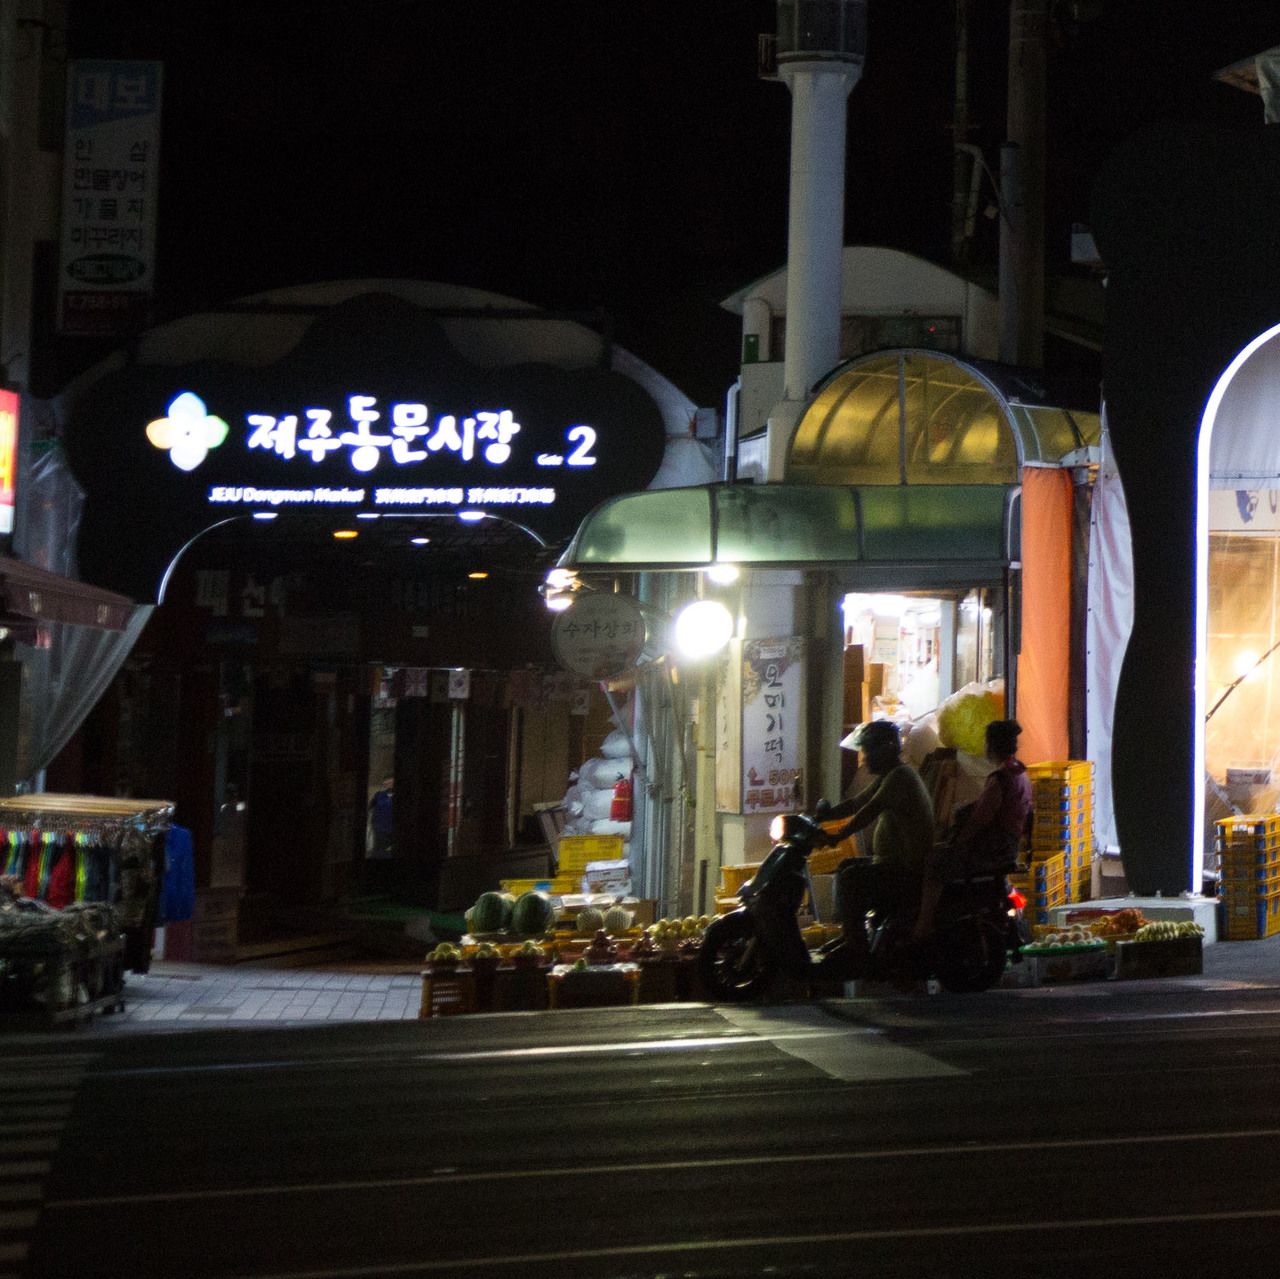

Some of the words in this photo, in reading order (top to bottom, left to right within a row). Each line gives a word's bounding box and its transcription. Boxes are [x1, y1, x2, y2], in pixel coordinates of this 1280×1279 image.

[247, 395, 522, 472] 제주동문시장
[567, 425, 597, 466] 2
[208, 486, 242, 503] JEJU
[764, 664, 786, 763] 오메기떡
